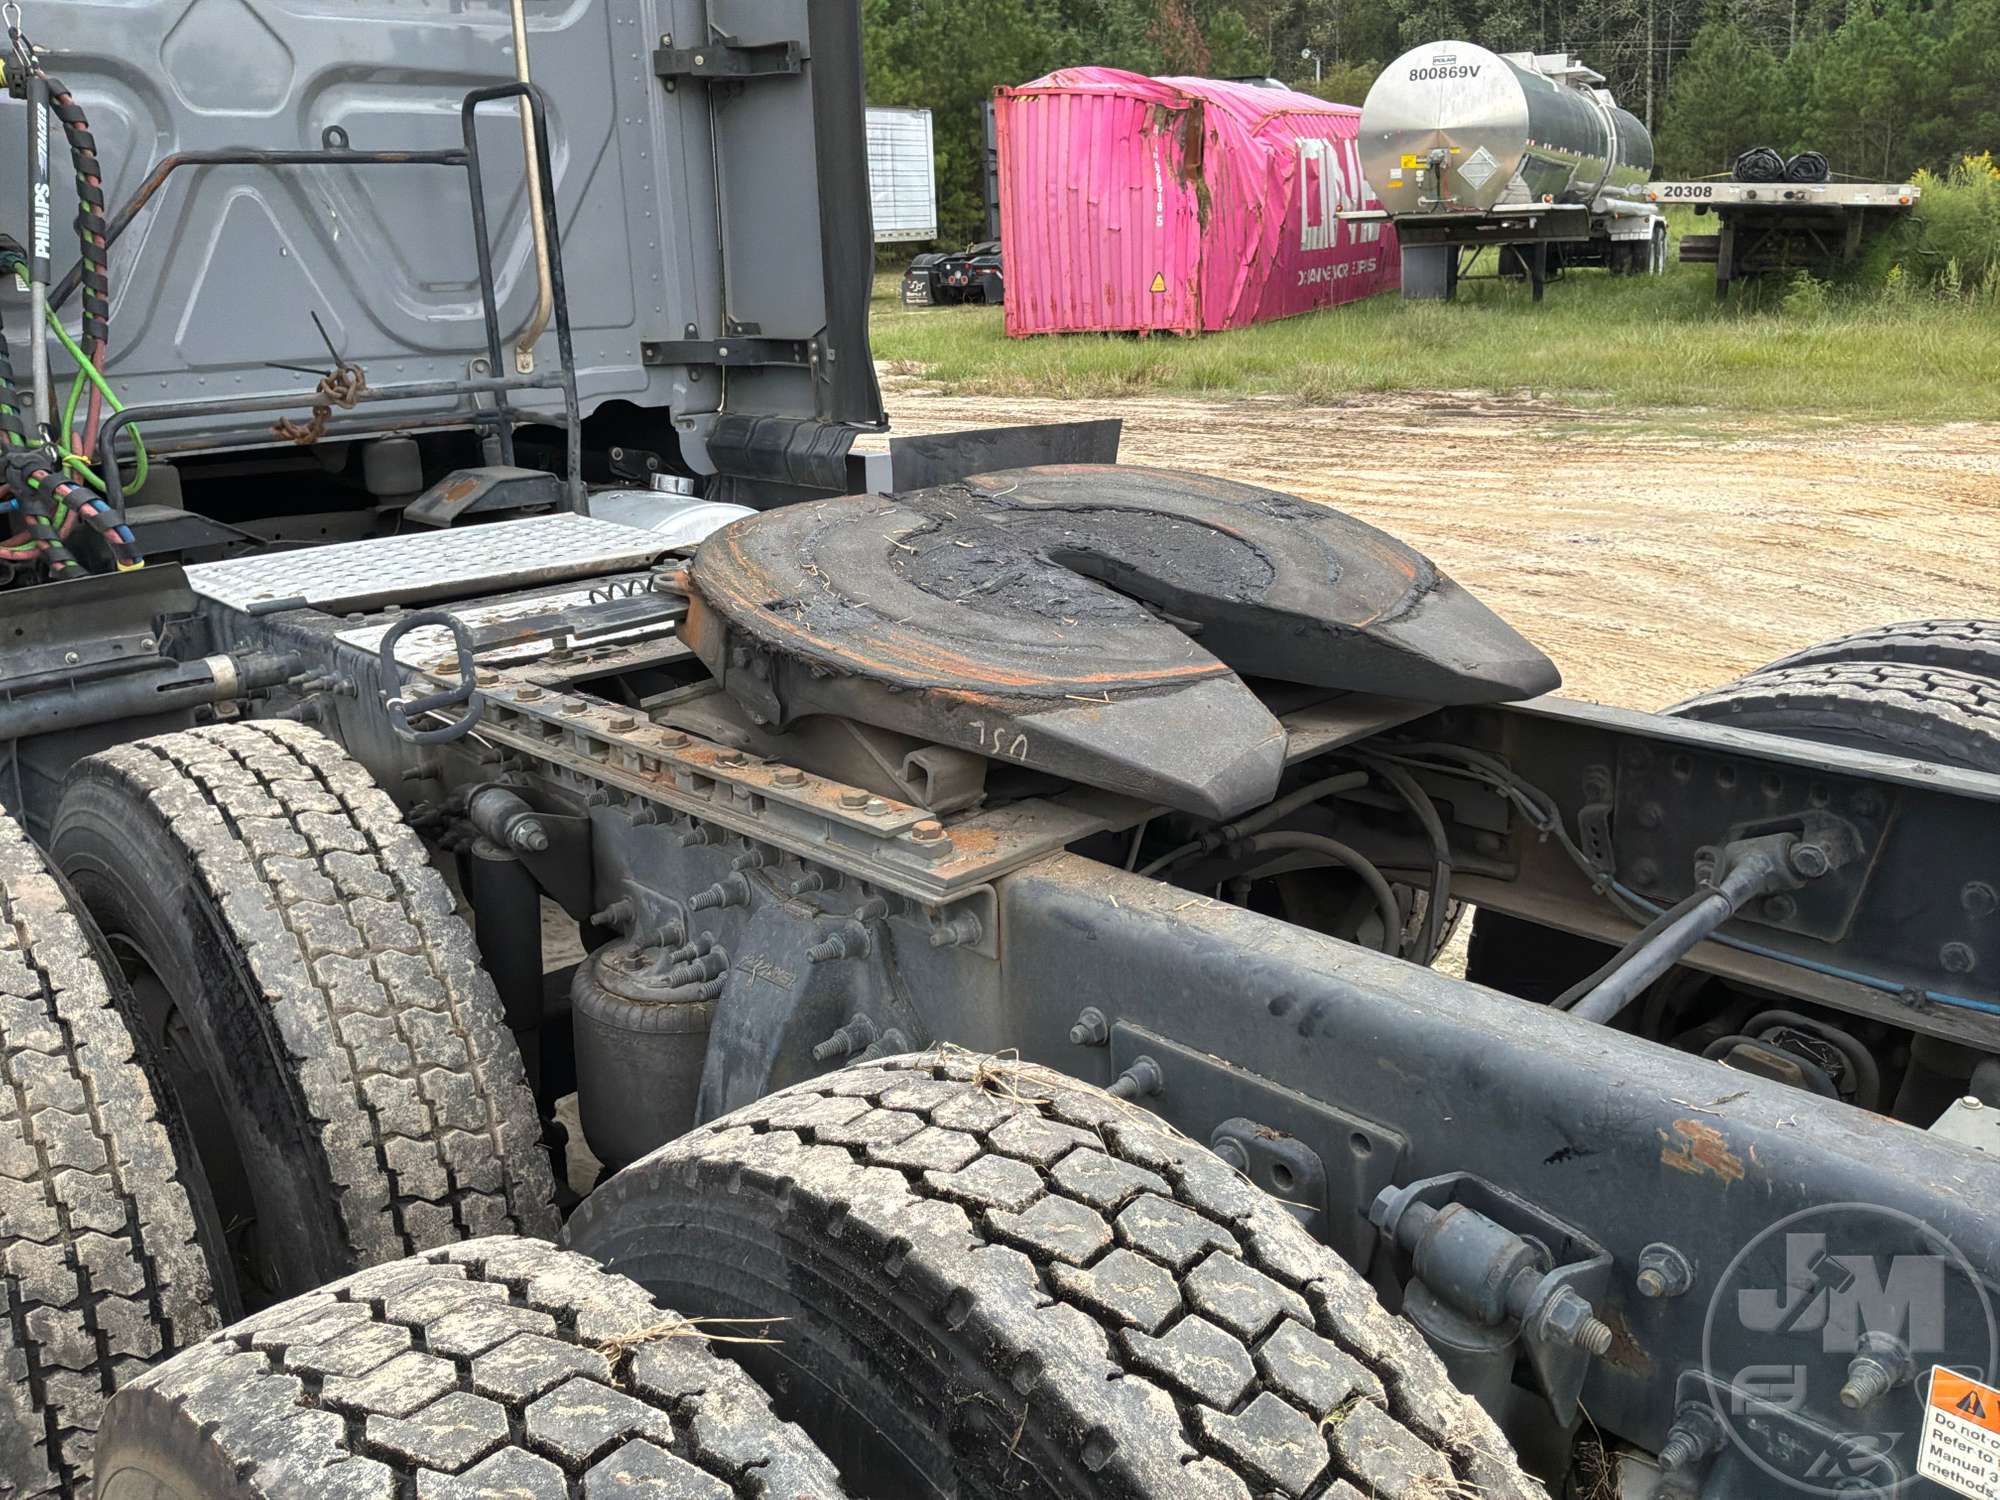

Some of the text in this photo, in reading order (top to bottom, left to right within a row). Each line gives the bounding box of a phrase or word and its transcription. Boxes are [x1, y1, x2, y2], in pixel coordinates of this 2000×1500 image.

[1409, 65, 1481, 81] 800869V
[1664, 186, 1712, 198] 20308
[35, 183, 50, 259] PHILLIPS
[1935, 1412, 1956, 1430] Do
[1960, 1425, 1986, 1444] not
[1930, 1444, 1985, 1477] Manual
[1932, 1428, 1974, 1453] Refer
[1977, 1449, 1993, 1463] to
